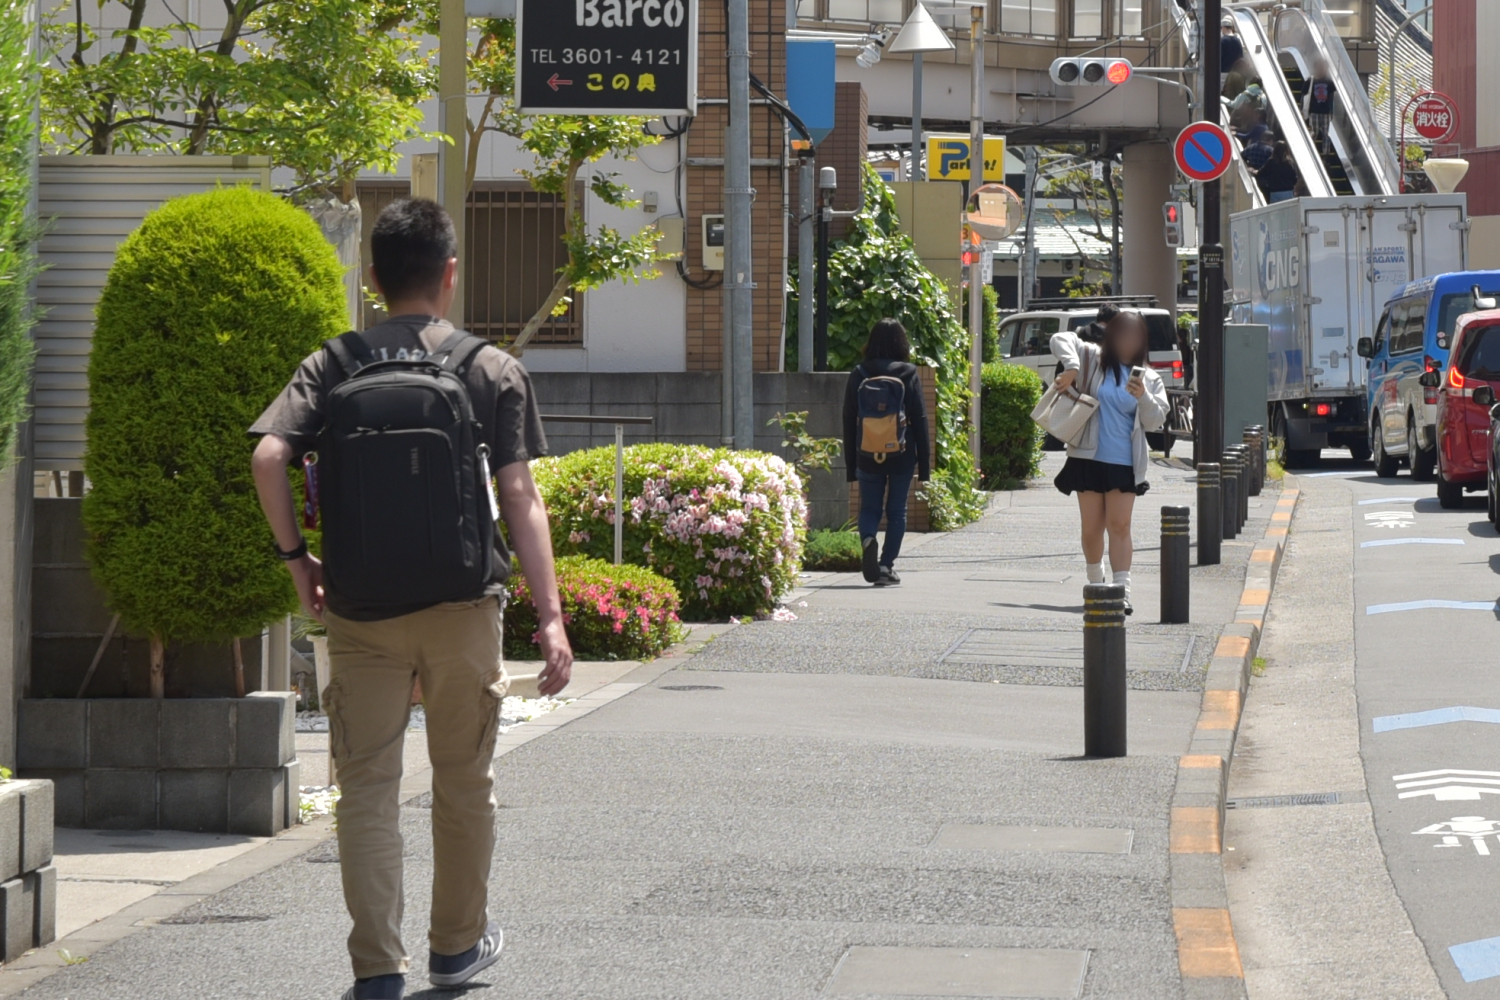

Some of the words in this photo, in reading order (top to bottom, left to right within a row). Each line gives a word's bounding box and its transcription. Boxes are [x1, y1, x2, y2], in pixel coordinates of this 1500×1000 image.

[531, 48, 558, 64] TEL
[586, 73, 657, 93] この奥
[1416, 111, 1449, 128] 消火栓
[1366, 255, 1405, 264] SAGAWA
[1265, 246, 1299, 292] CNG
[410, 447, 419, 476] THULE
